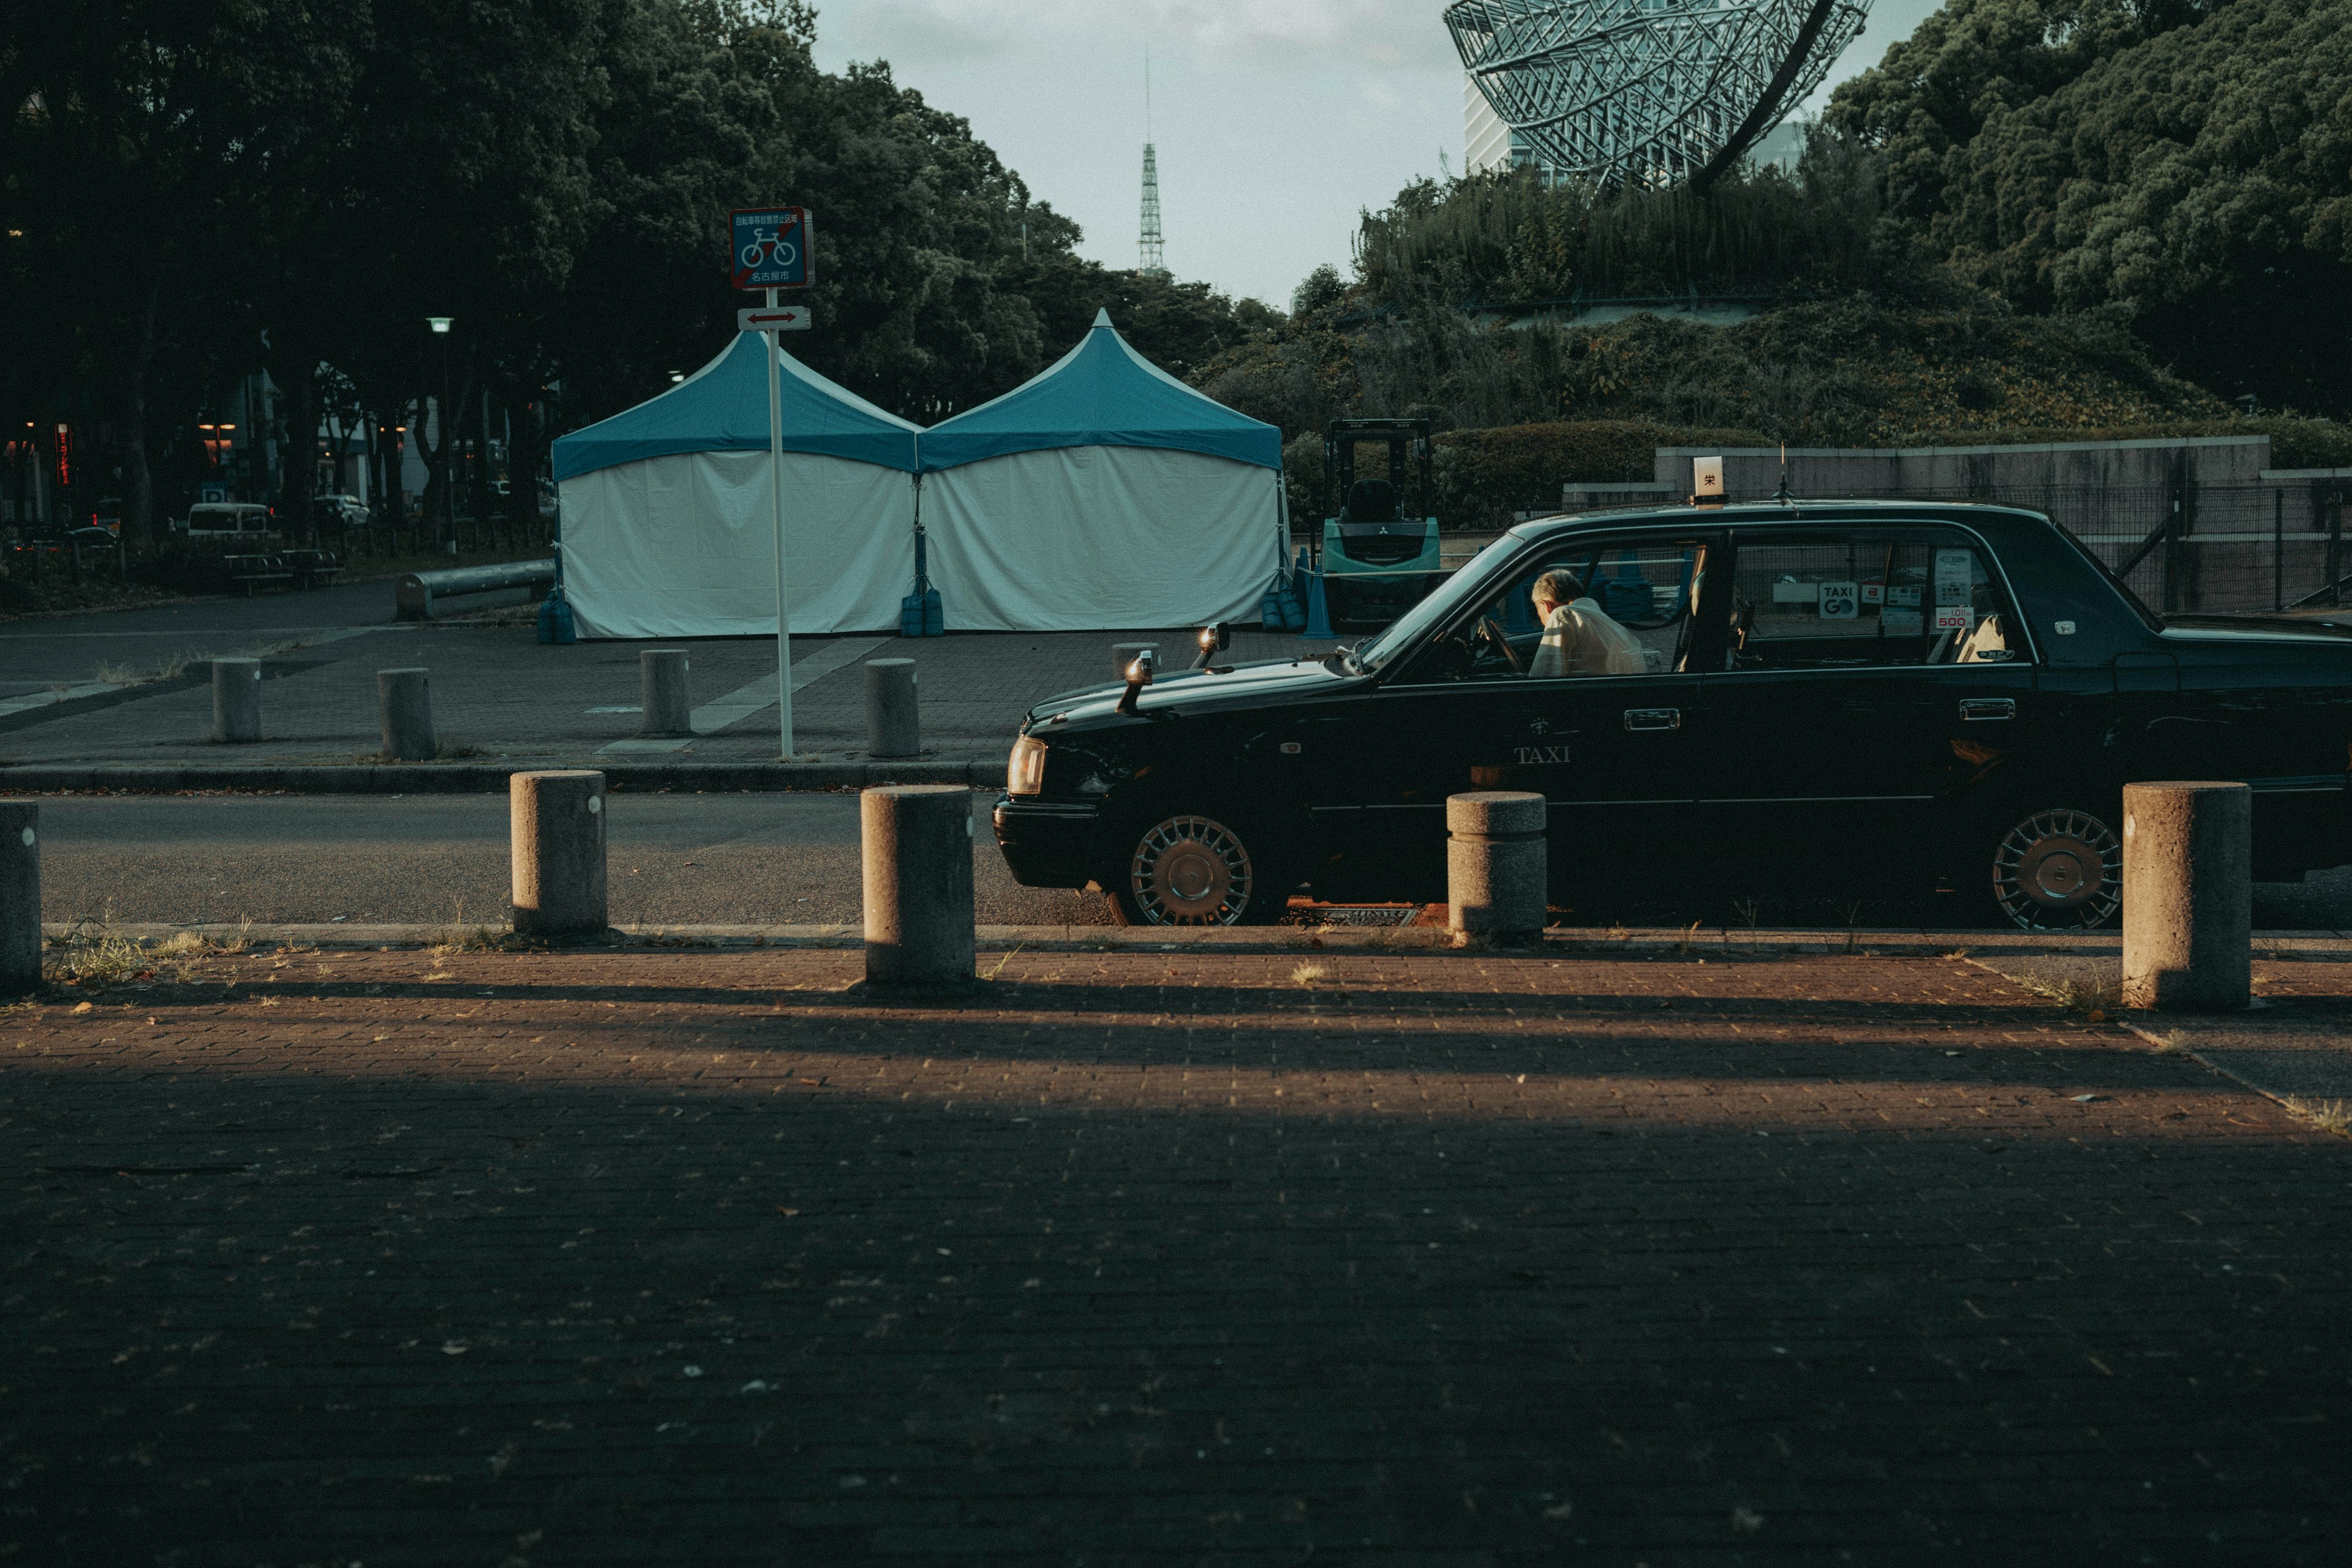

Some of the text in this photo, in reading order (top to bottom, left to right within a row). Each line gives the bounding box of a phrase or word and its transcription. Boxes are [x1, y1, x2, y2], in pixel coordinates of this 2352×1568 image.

[736, 214, 797, 226] 自転車等放置禁止区域
[752, 271, 790, 282] 名古屋市
[1705, 475, 1716, 486] 栄
[1824, 587, 1852, 597] TAXI
[1513, 746, 1572, 764] TAXI
